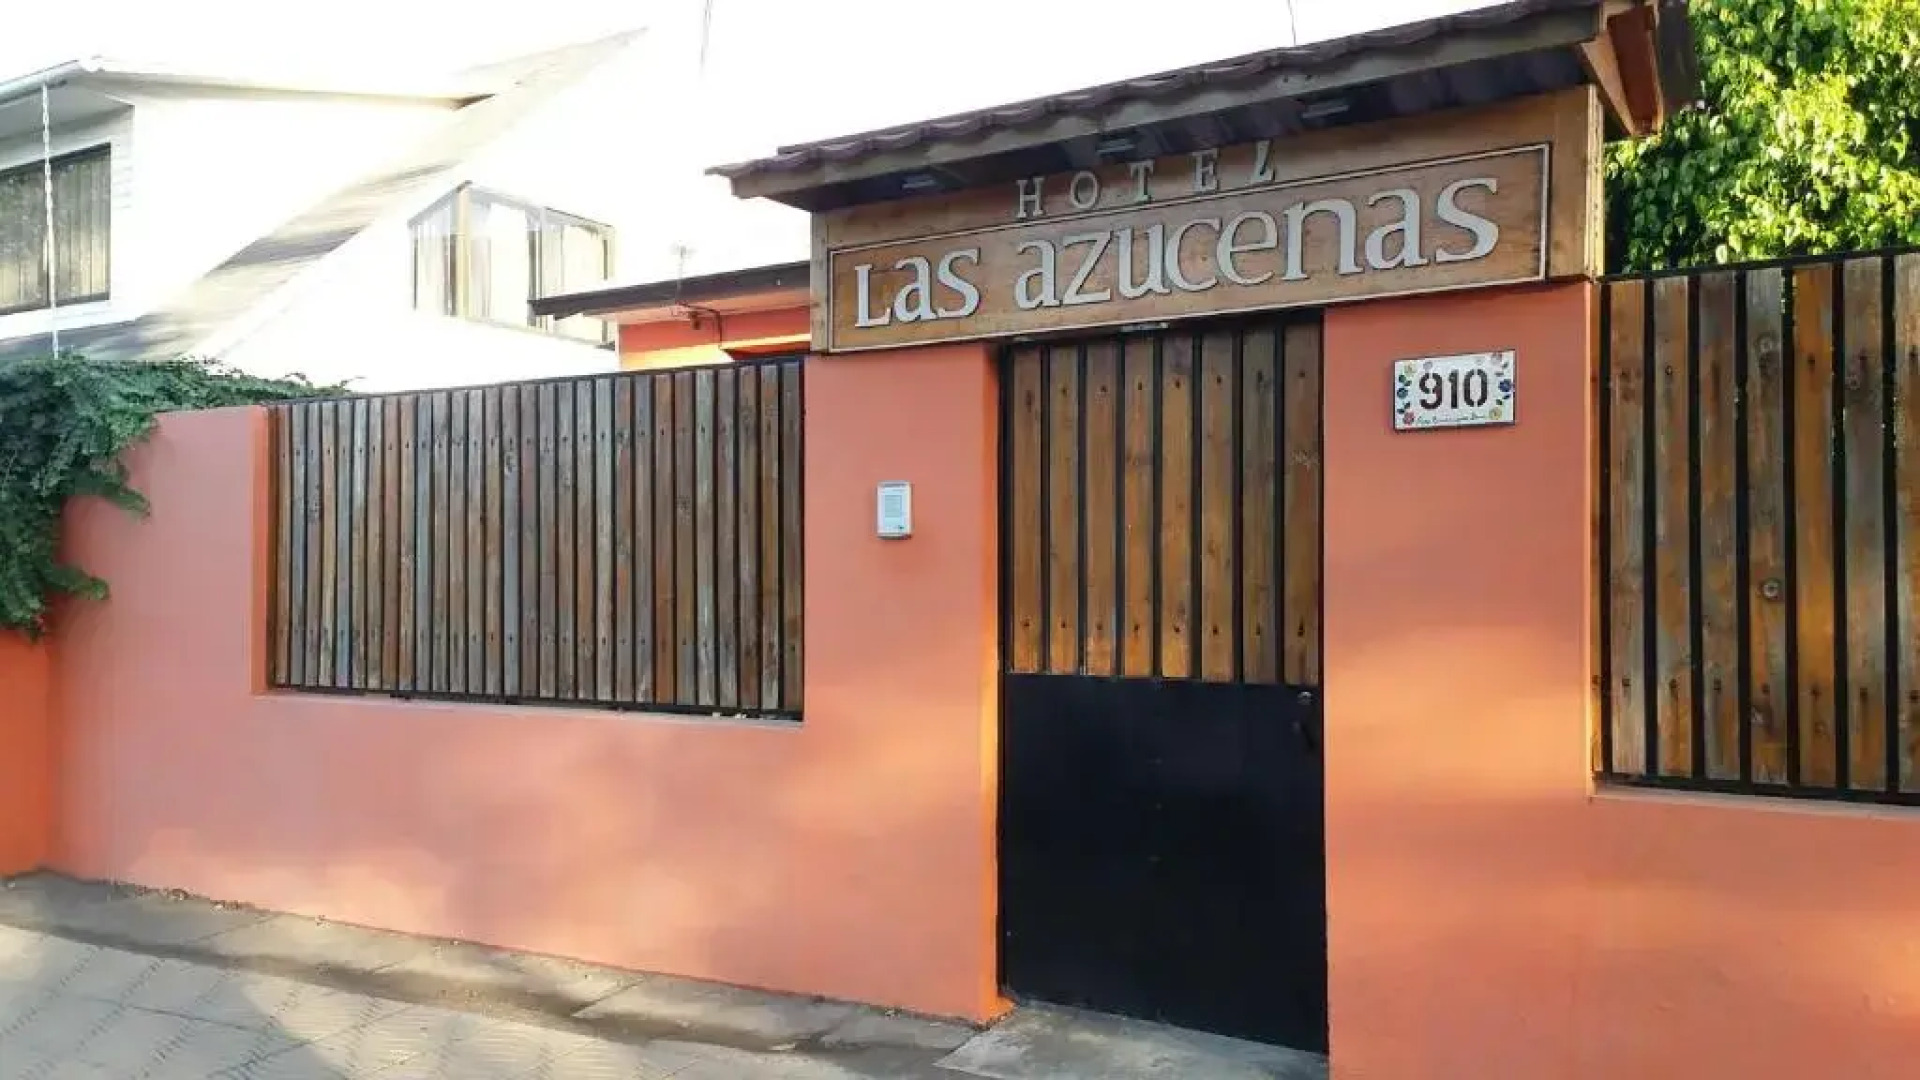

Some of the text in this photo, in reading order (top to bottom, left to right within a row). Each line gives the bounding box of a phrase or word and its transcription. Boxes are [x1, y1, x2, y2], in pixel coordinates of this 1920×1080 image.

[1015, 139, 1275, 219] HOTEL
[1014, 177, 1500, 310] azucenas
[1419, 368, 1488, 410] 910
